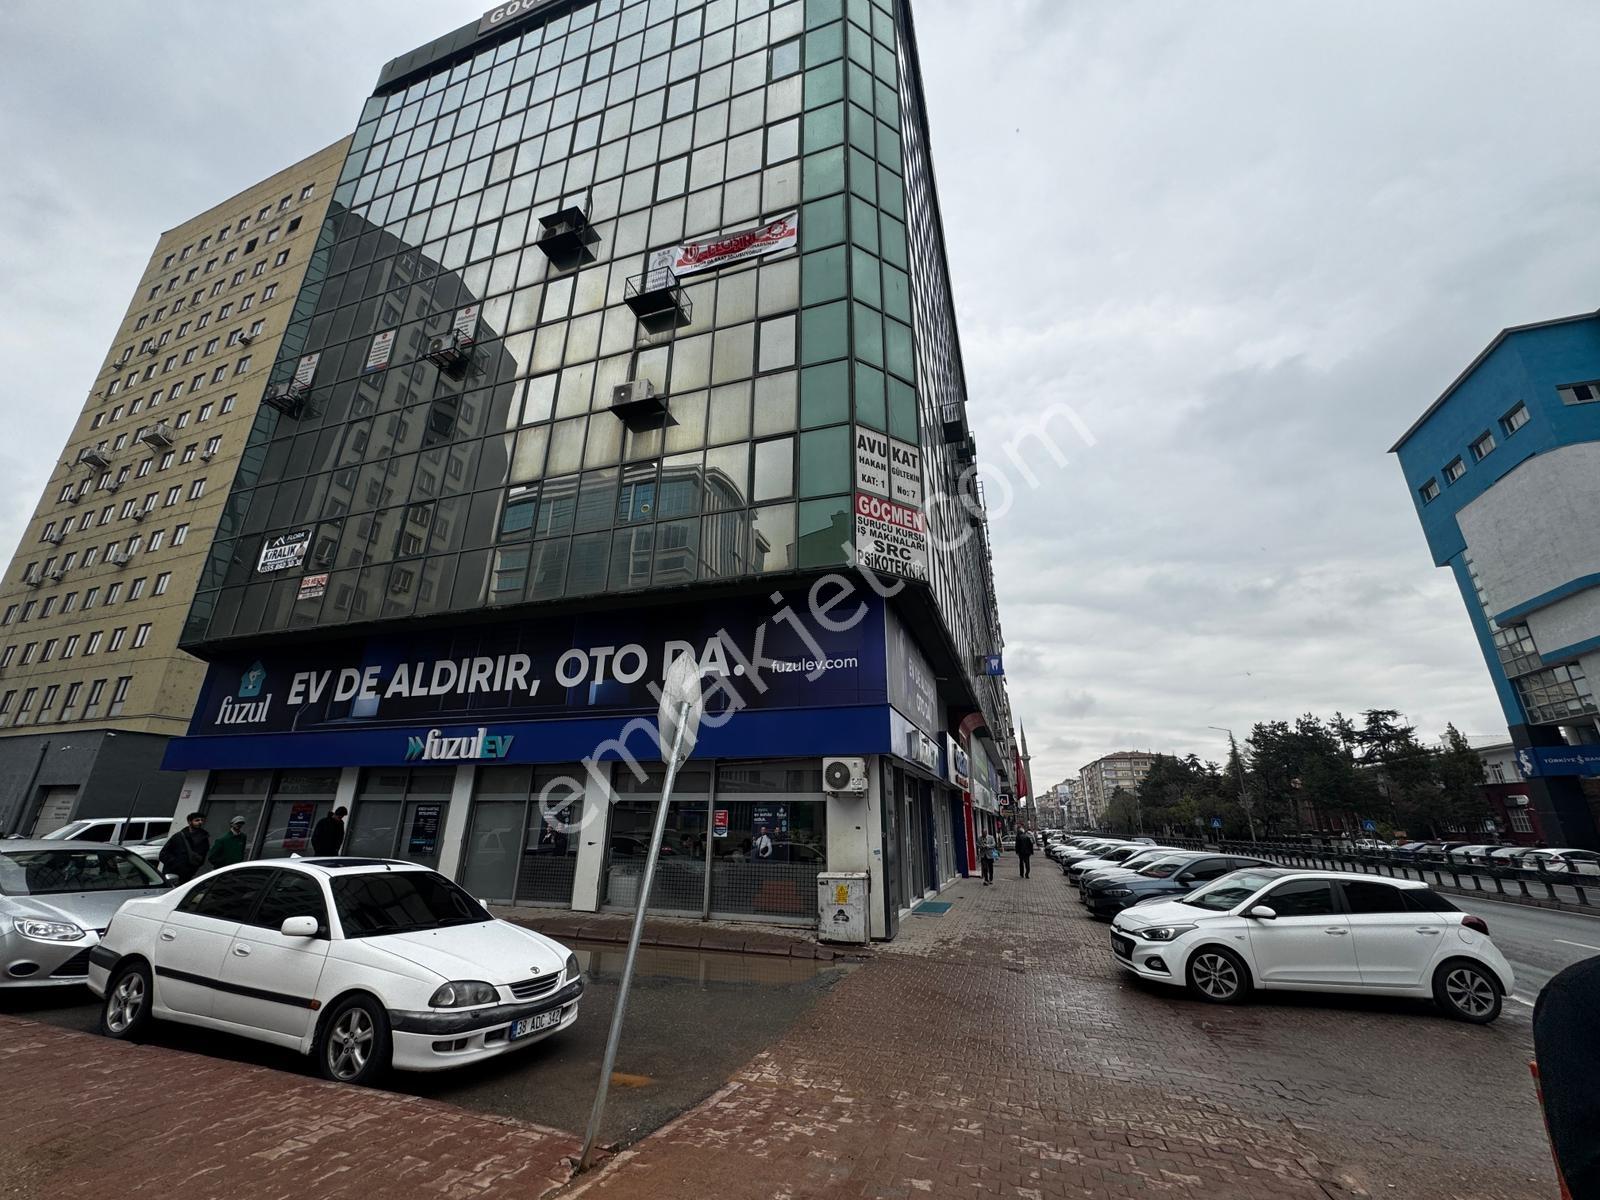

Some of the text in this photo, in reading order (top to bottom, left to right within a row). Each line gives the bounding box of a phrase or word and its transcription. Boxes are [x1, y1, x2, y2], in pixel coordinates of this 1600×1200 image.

[859, 456, 887, 472] HAKAN
[861, 473, 878, 487] KAT:
[897, 485, 910, 497] No:
[911, 490, 916, 499] 7
[858, 495, 925, 532] GÖÇMEN
[895, 526, 925, 543] KURSU
[873, 539, 912, 560] SRC
[287, 670, 332, 705] EV
[334, 666, 382, 702] DE
[384, 653, 541, 699] ALDIRIR,
[555, 643, 648, 688] OTO
[771, 656, 858, 674] fuzulev.com
[214, 693, 272, 725] fuzul
[517, 1019, 527, 1035] 38
